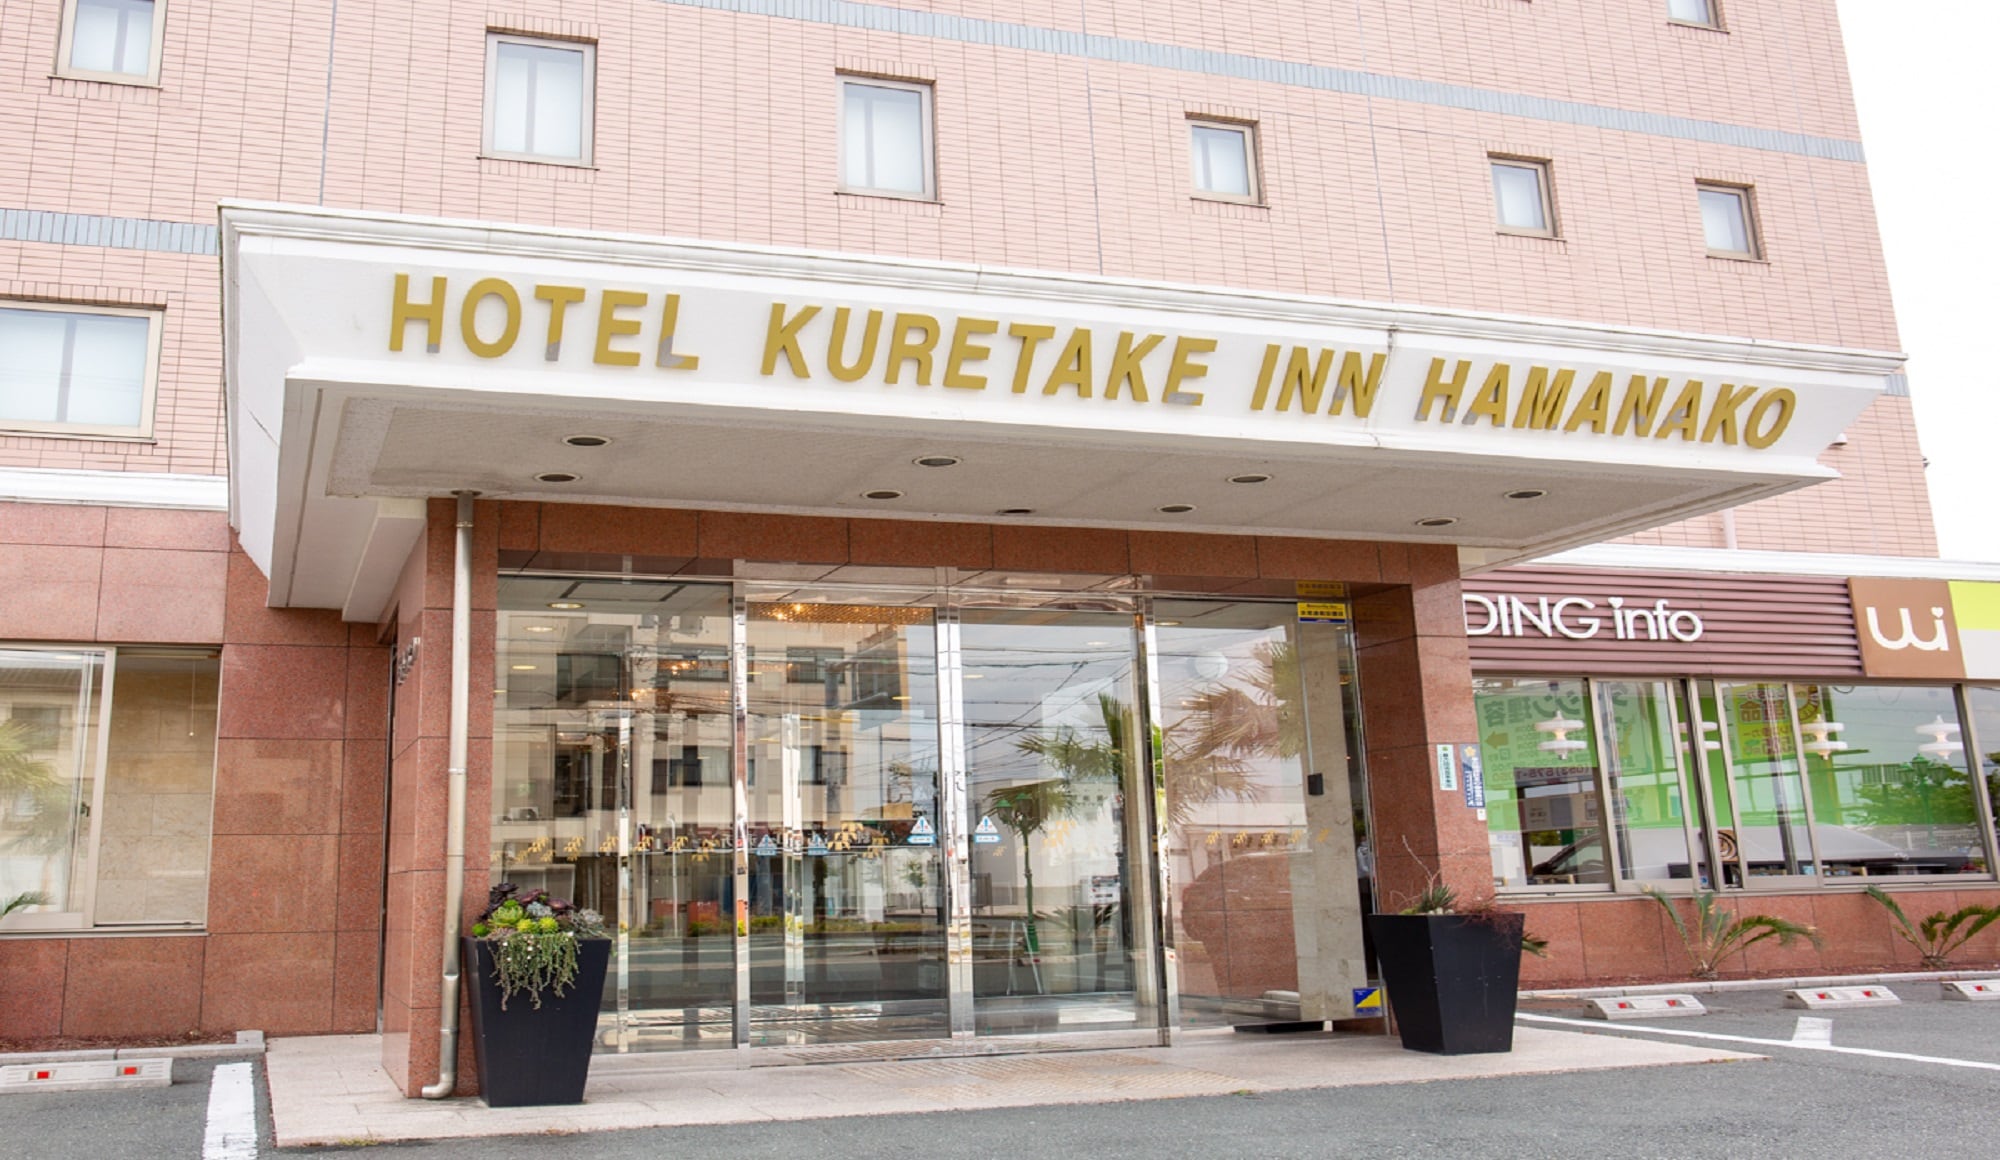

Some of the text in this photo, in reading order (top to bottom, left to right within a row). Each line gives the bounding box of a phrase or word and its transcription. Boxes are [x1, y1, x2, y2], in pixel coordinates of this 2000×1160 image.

[389, 273, 1797, 450] HOTEL KURETAKE INN HAMANAKO
[1462, 594, 1703, 642] DING info
